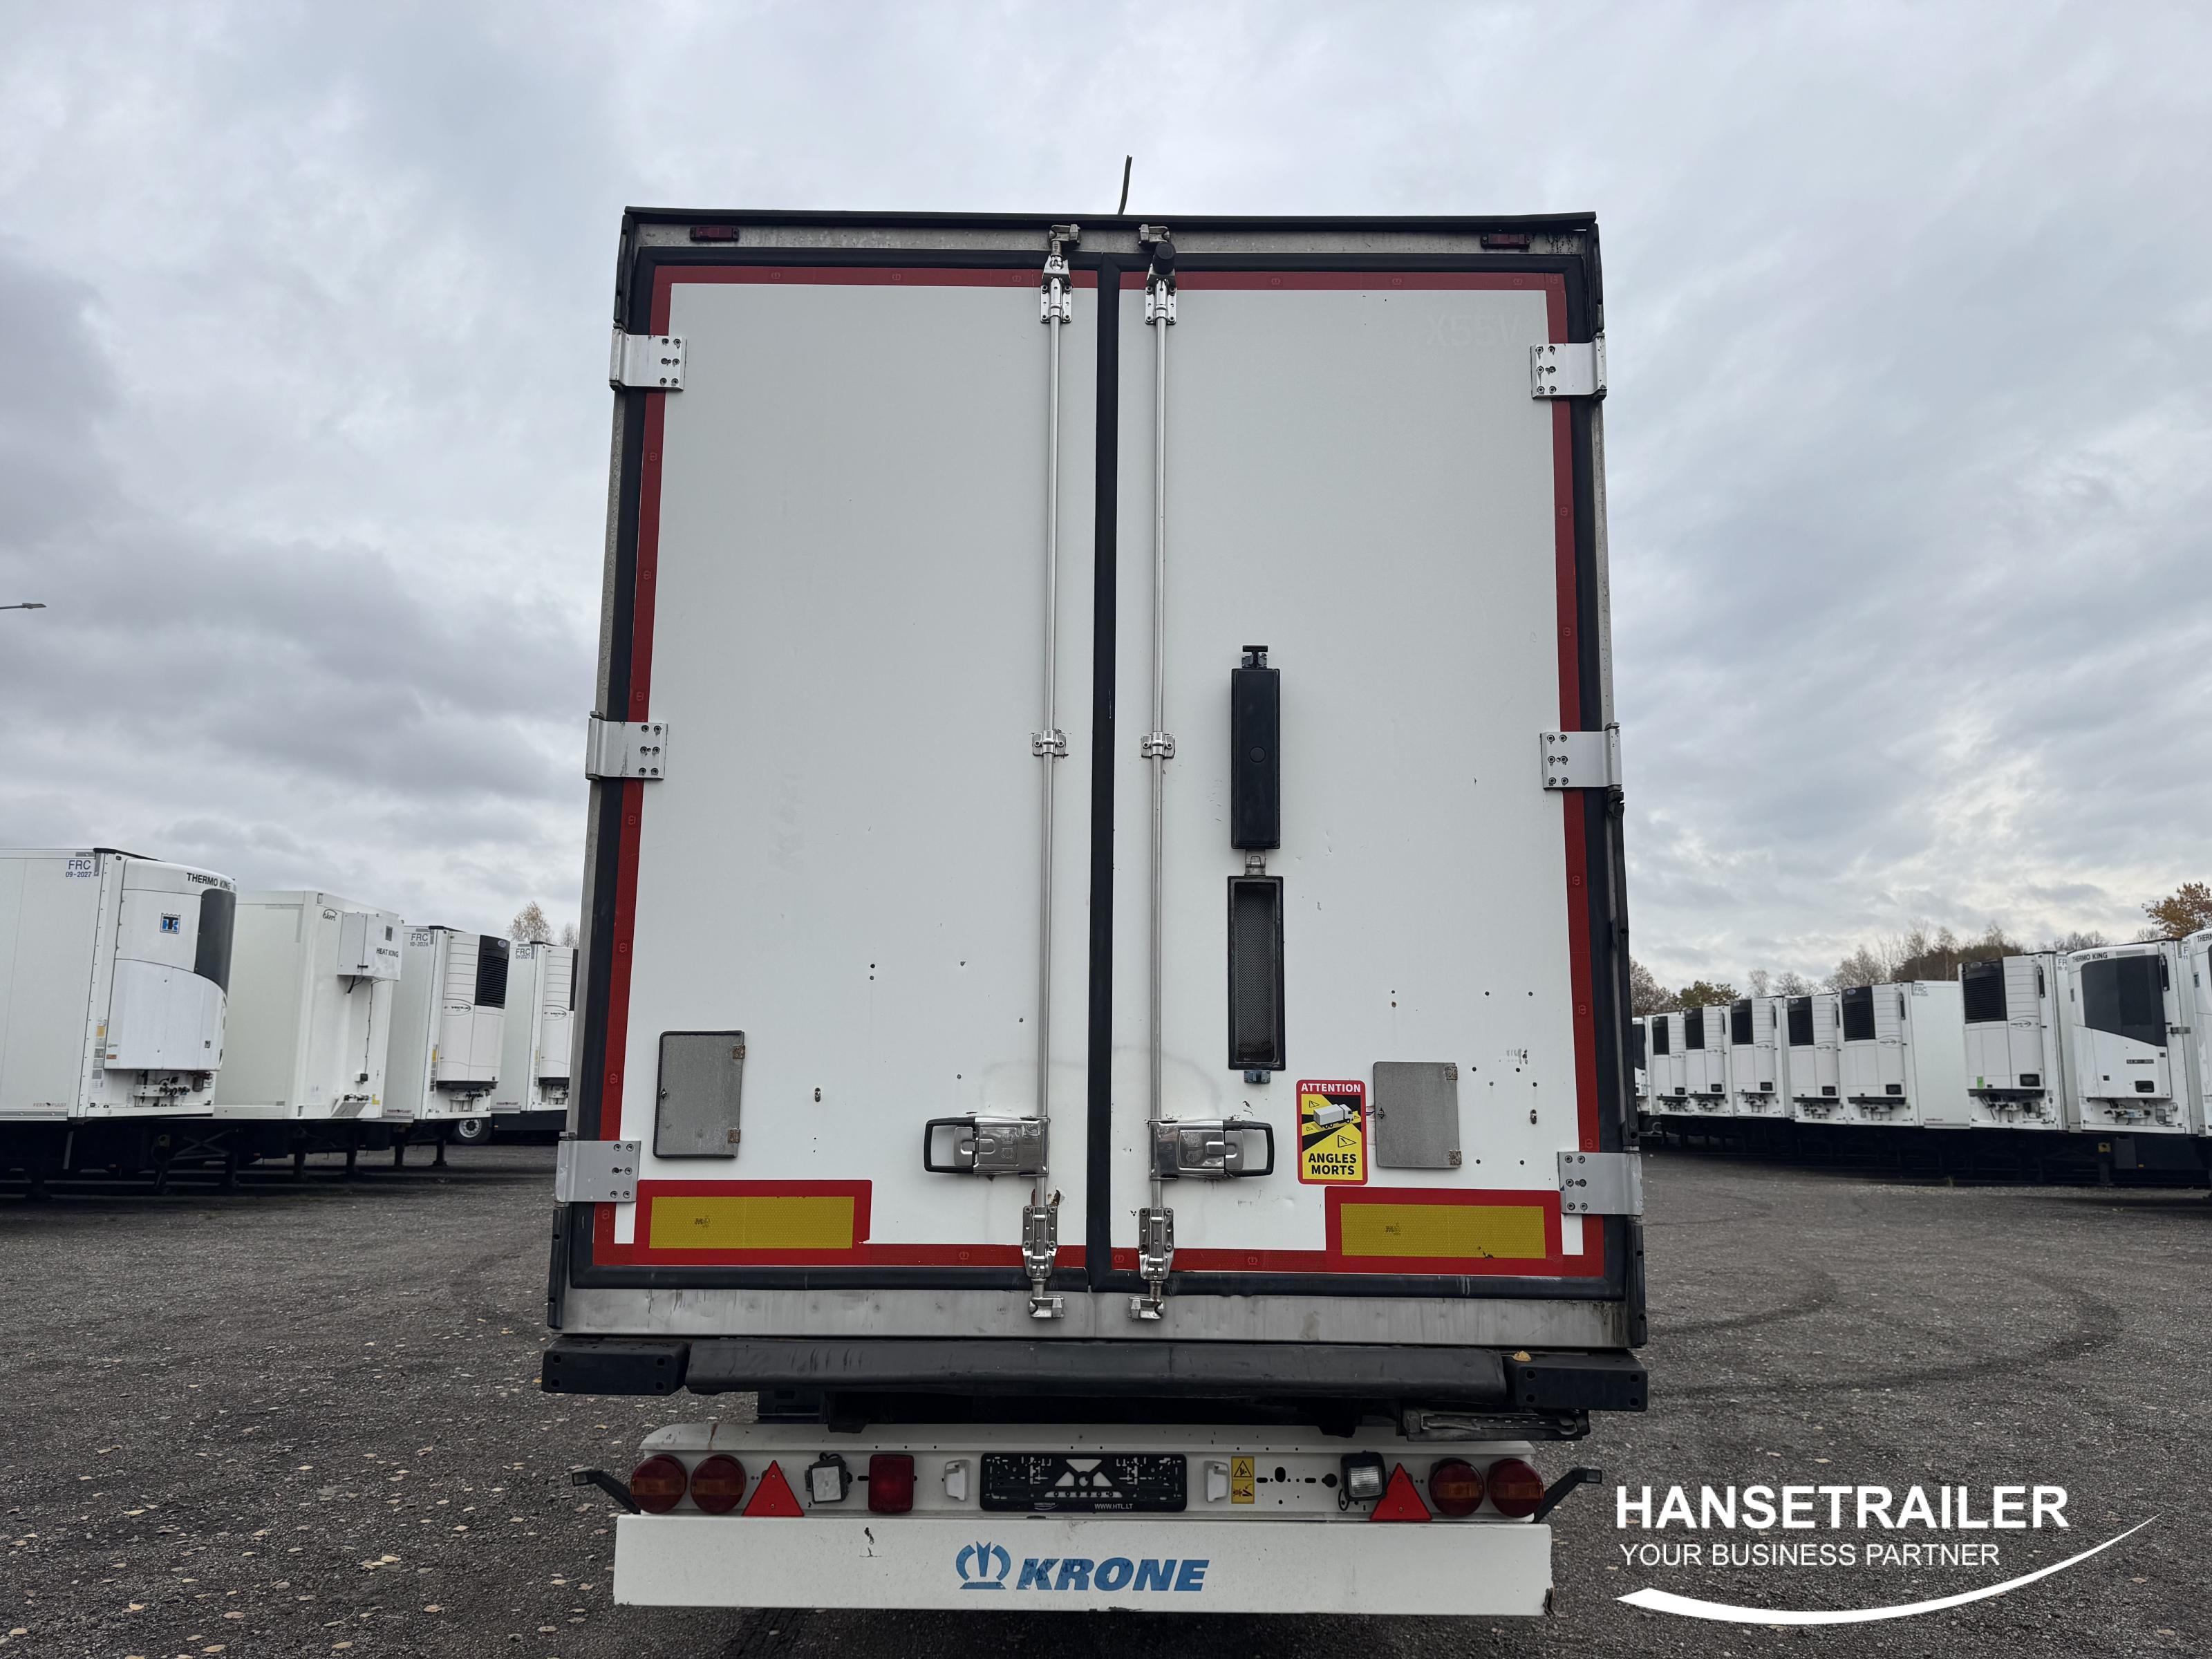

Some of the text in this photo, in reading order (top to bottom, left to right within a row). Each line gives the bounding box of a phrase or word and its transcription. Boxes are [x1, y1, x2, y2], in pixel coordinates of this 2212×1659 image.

[68, 859, 91, 870] FRC
[186, 872, 231, 891] THERMO KING
[375, 947, 400, 958] HEAT KING
[2072, 951, 2108, 963] THERMO KING
[1301, 1082, 1361, 1093] ATTENTION
[1308, 1153, 1357, 1164] ANGLES
[1311, 1164, 1356, 1175] MORTS
[1015, 1557, 1210, 1592] KRONE
